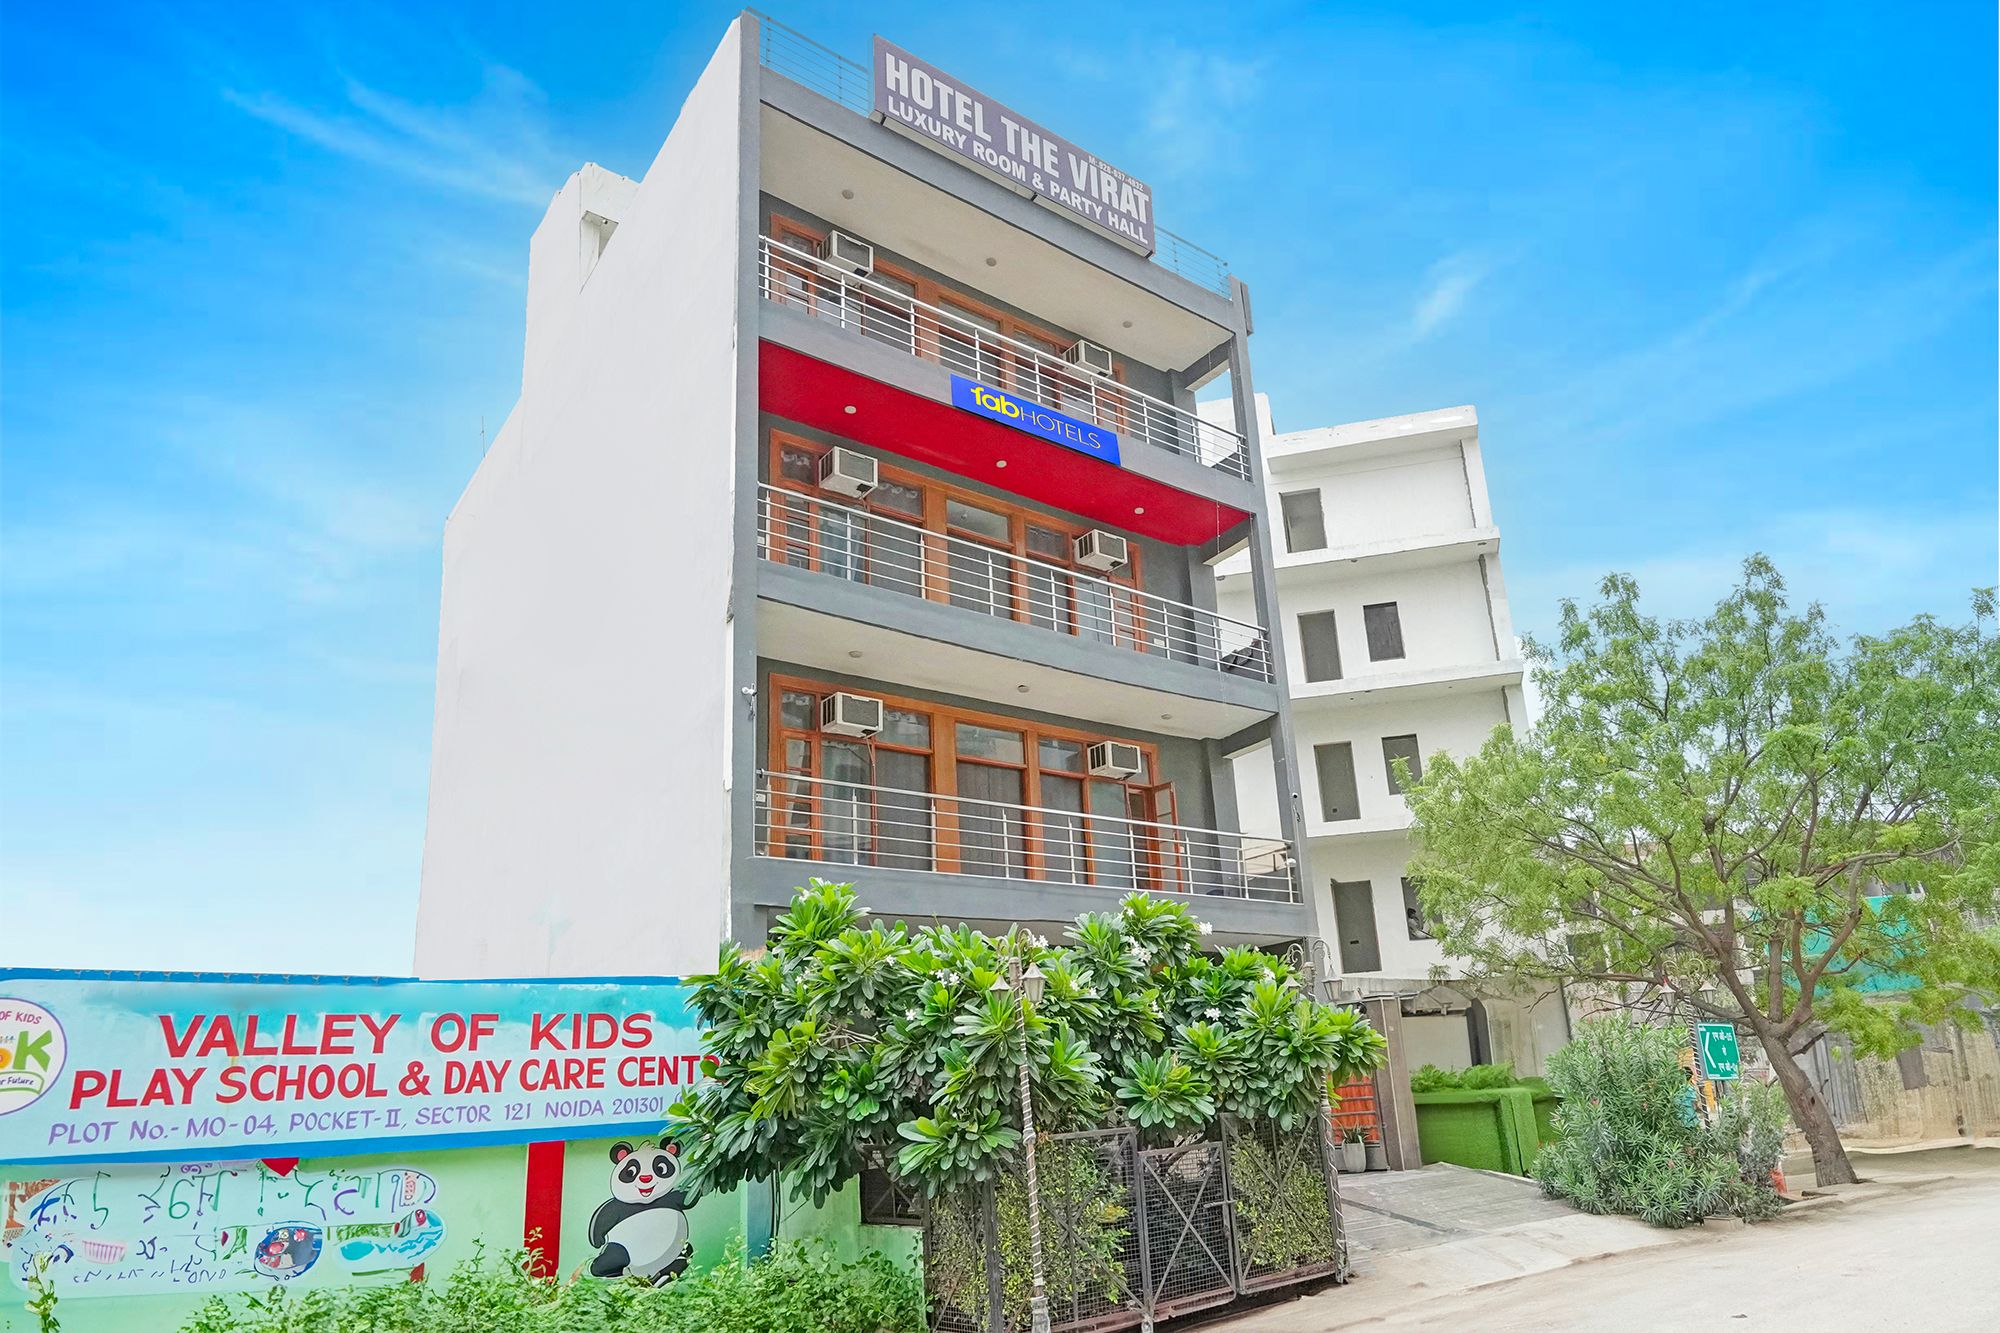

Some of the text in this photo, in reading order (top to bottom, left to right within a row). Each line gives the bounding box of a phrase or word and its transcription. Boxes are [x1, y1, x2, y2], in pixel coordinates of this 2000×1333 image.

[886, 52, 1149, 225] HOTEL THE VIRAT
[888, 96, 1148, 244] LUXURY ROOM & PARTY HALL
[15, 1011, 42, 1025] KIDS
[158, 1013, 653, 1058] VALLEY OF KIDS
[7, 1077, 34, 1086] Future
[69, 1067, 208, 1110] PLAY
[215, 1063, 388, 1104] SCHOOL
[399, 1061, 432, 1097] &
[443, 1060, 512, 1095] DAY
[519, 1056, 606, 1091] CARE
[48, 1120, 119, 1146] PLOT
[415, 1104, 491, 1126] SECTOR
[504, 1102, 531, 1121] 121
[545, 1100, 604, 1119] NOIDA
[612, 1096, 664, 1116] 201301
